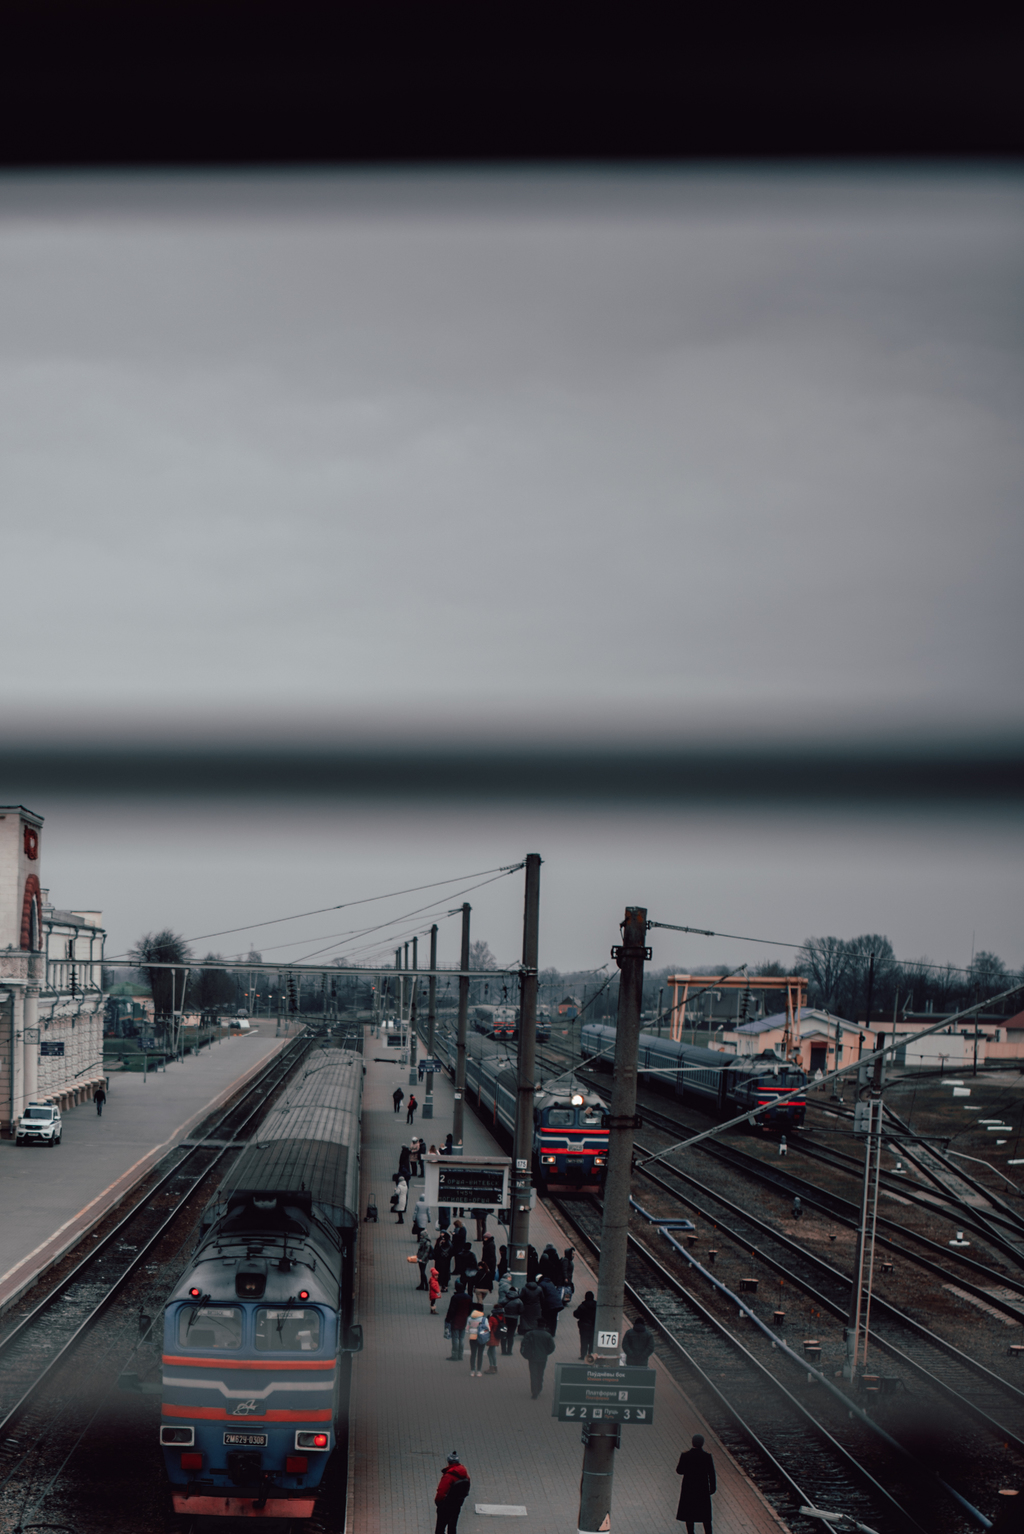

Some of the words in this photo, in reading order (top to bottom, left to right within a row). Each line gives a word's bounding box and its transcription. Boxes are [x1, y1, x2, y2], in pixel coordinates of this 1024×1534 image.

[439, 1174, 446, 1183] 2
[496, 1193, 503, 1202] 3
[600, 1334, 617, 1346] 176
[587, 1370, 615, 1378] Паўднёвы
[579, 1407, 587, 1418] 2
[623, 1409, 631, 1420] 3
[225, 1434, 265, 1445] 2М62У-0308
